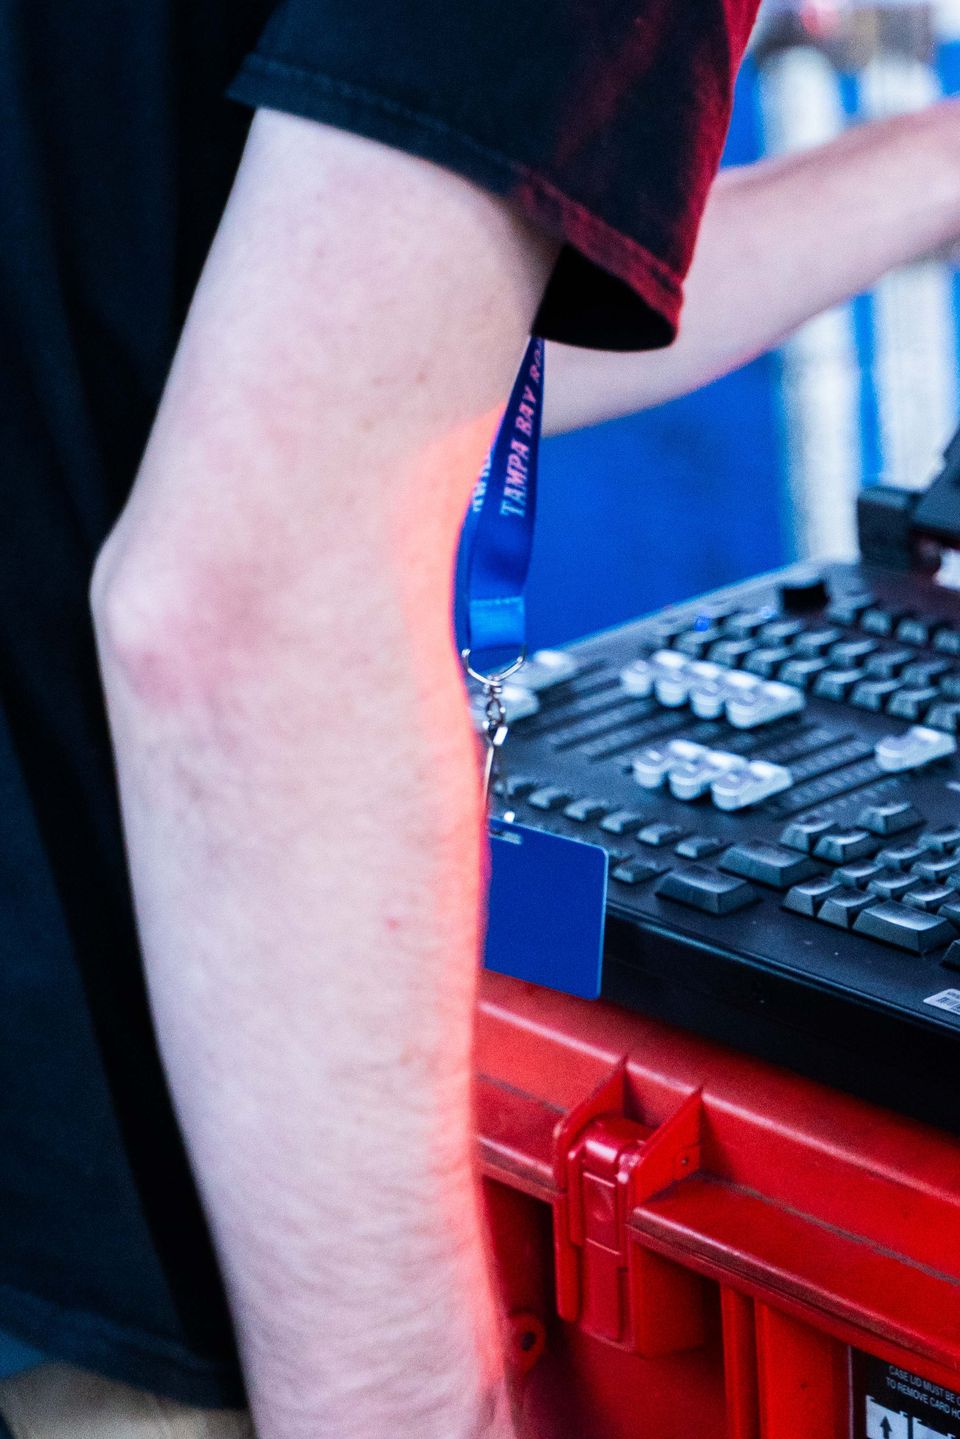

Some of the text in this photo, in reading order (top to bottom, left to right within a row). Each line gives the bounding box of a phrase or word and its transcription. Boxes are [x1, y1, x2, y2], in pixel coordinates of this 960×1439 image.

[500, 439, 528, 518] TAMPA
[515, 384, 537, 437] BAY
[886, 1376, 897, 1390] TO
[897, 1382, 929, 1404] REMOVE
[930, 1397, 951, 1414] CARD
[888, 1365, 909, 1382] CASE
[909, 1373, 922, 1388] LID
[923, 1380, 944, 1397] MUST
[945, 1391, 956, 1403] BE
